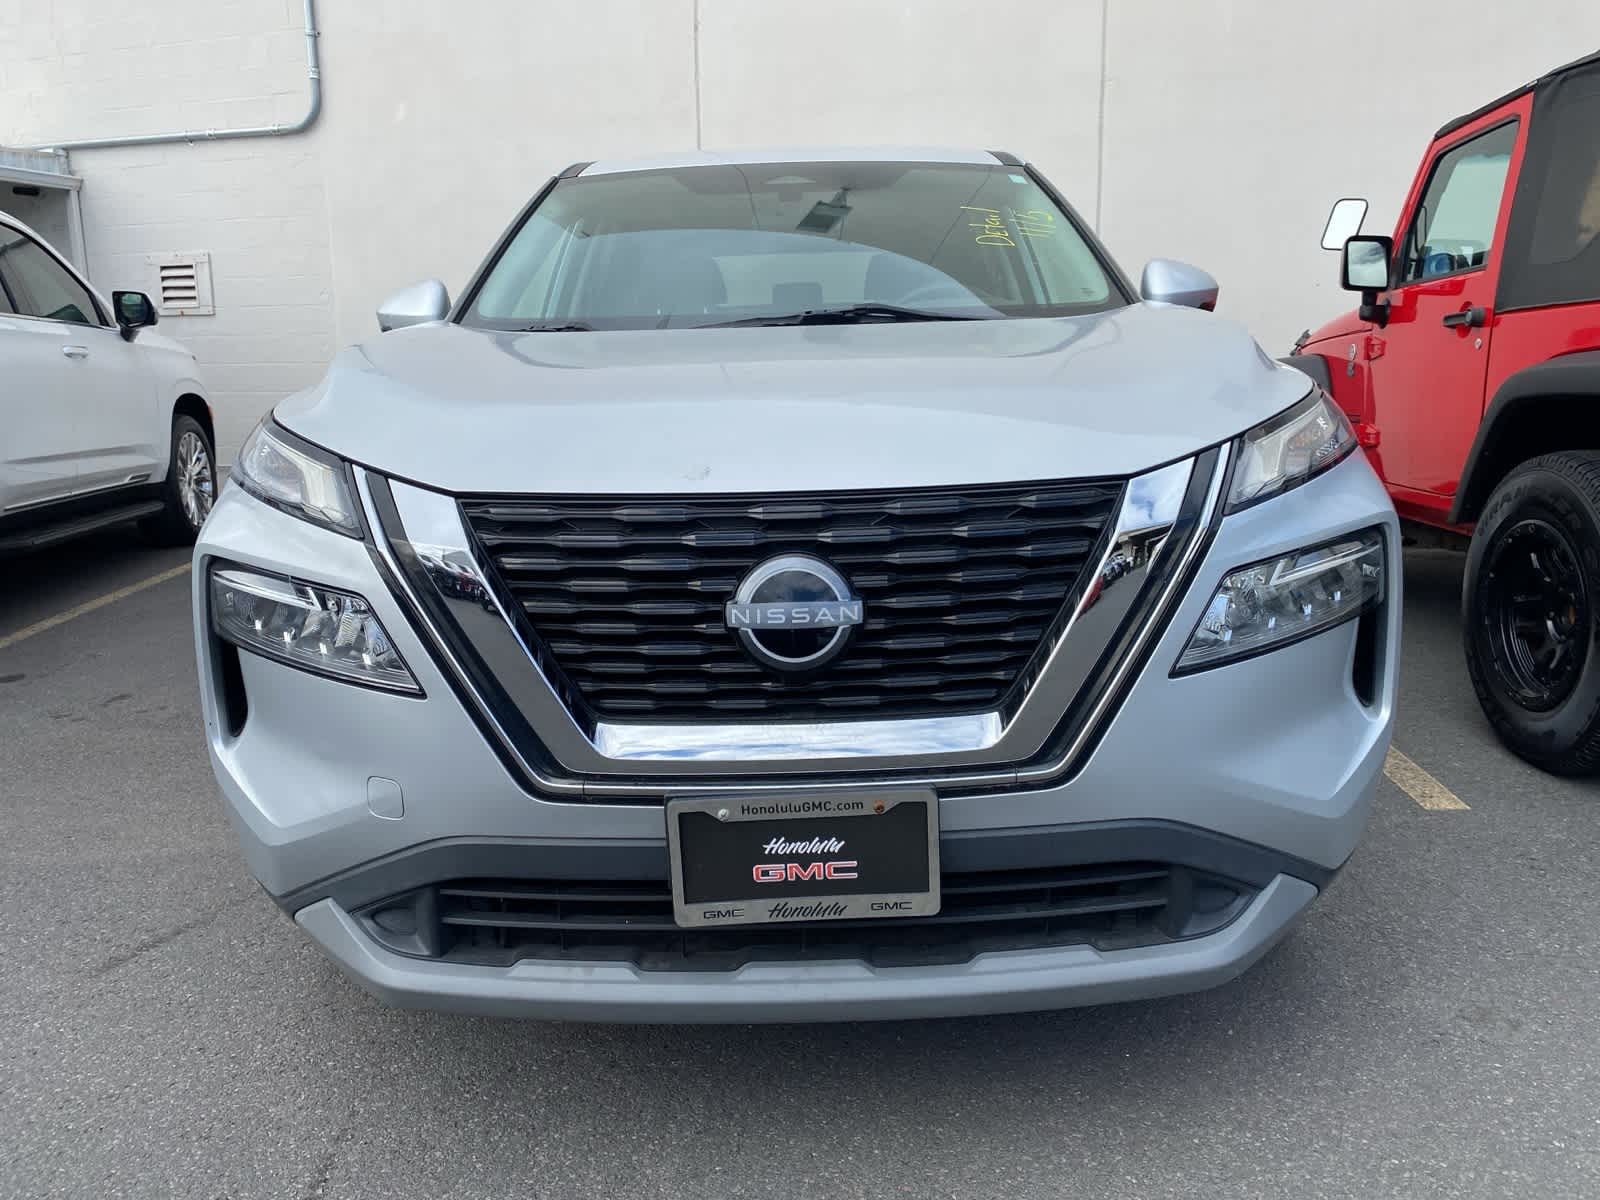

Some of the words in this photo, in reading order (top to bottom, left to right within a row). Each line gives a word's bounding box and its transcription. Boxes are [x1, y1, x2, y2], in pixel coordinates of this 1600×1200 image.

[731, 604, 859, 625] NISSAN
[740, 799, 865, 816] HonoluluGMC.com
[762, 836, 846, 855] Honolulu
[752, 860, 859, 883] GMC
[703, 908, 745, 920] GMC
[767, 901, 848, 920] Honolulu
[870, 901, 913, 912] GMC
